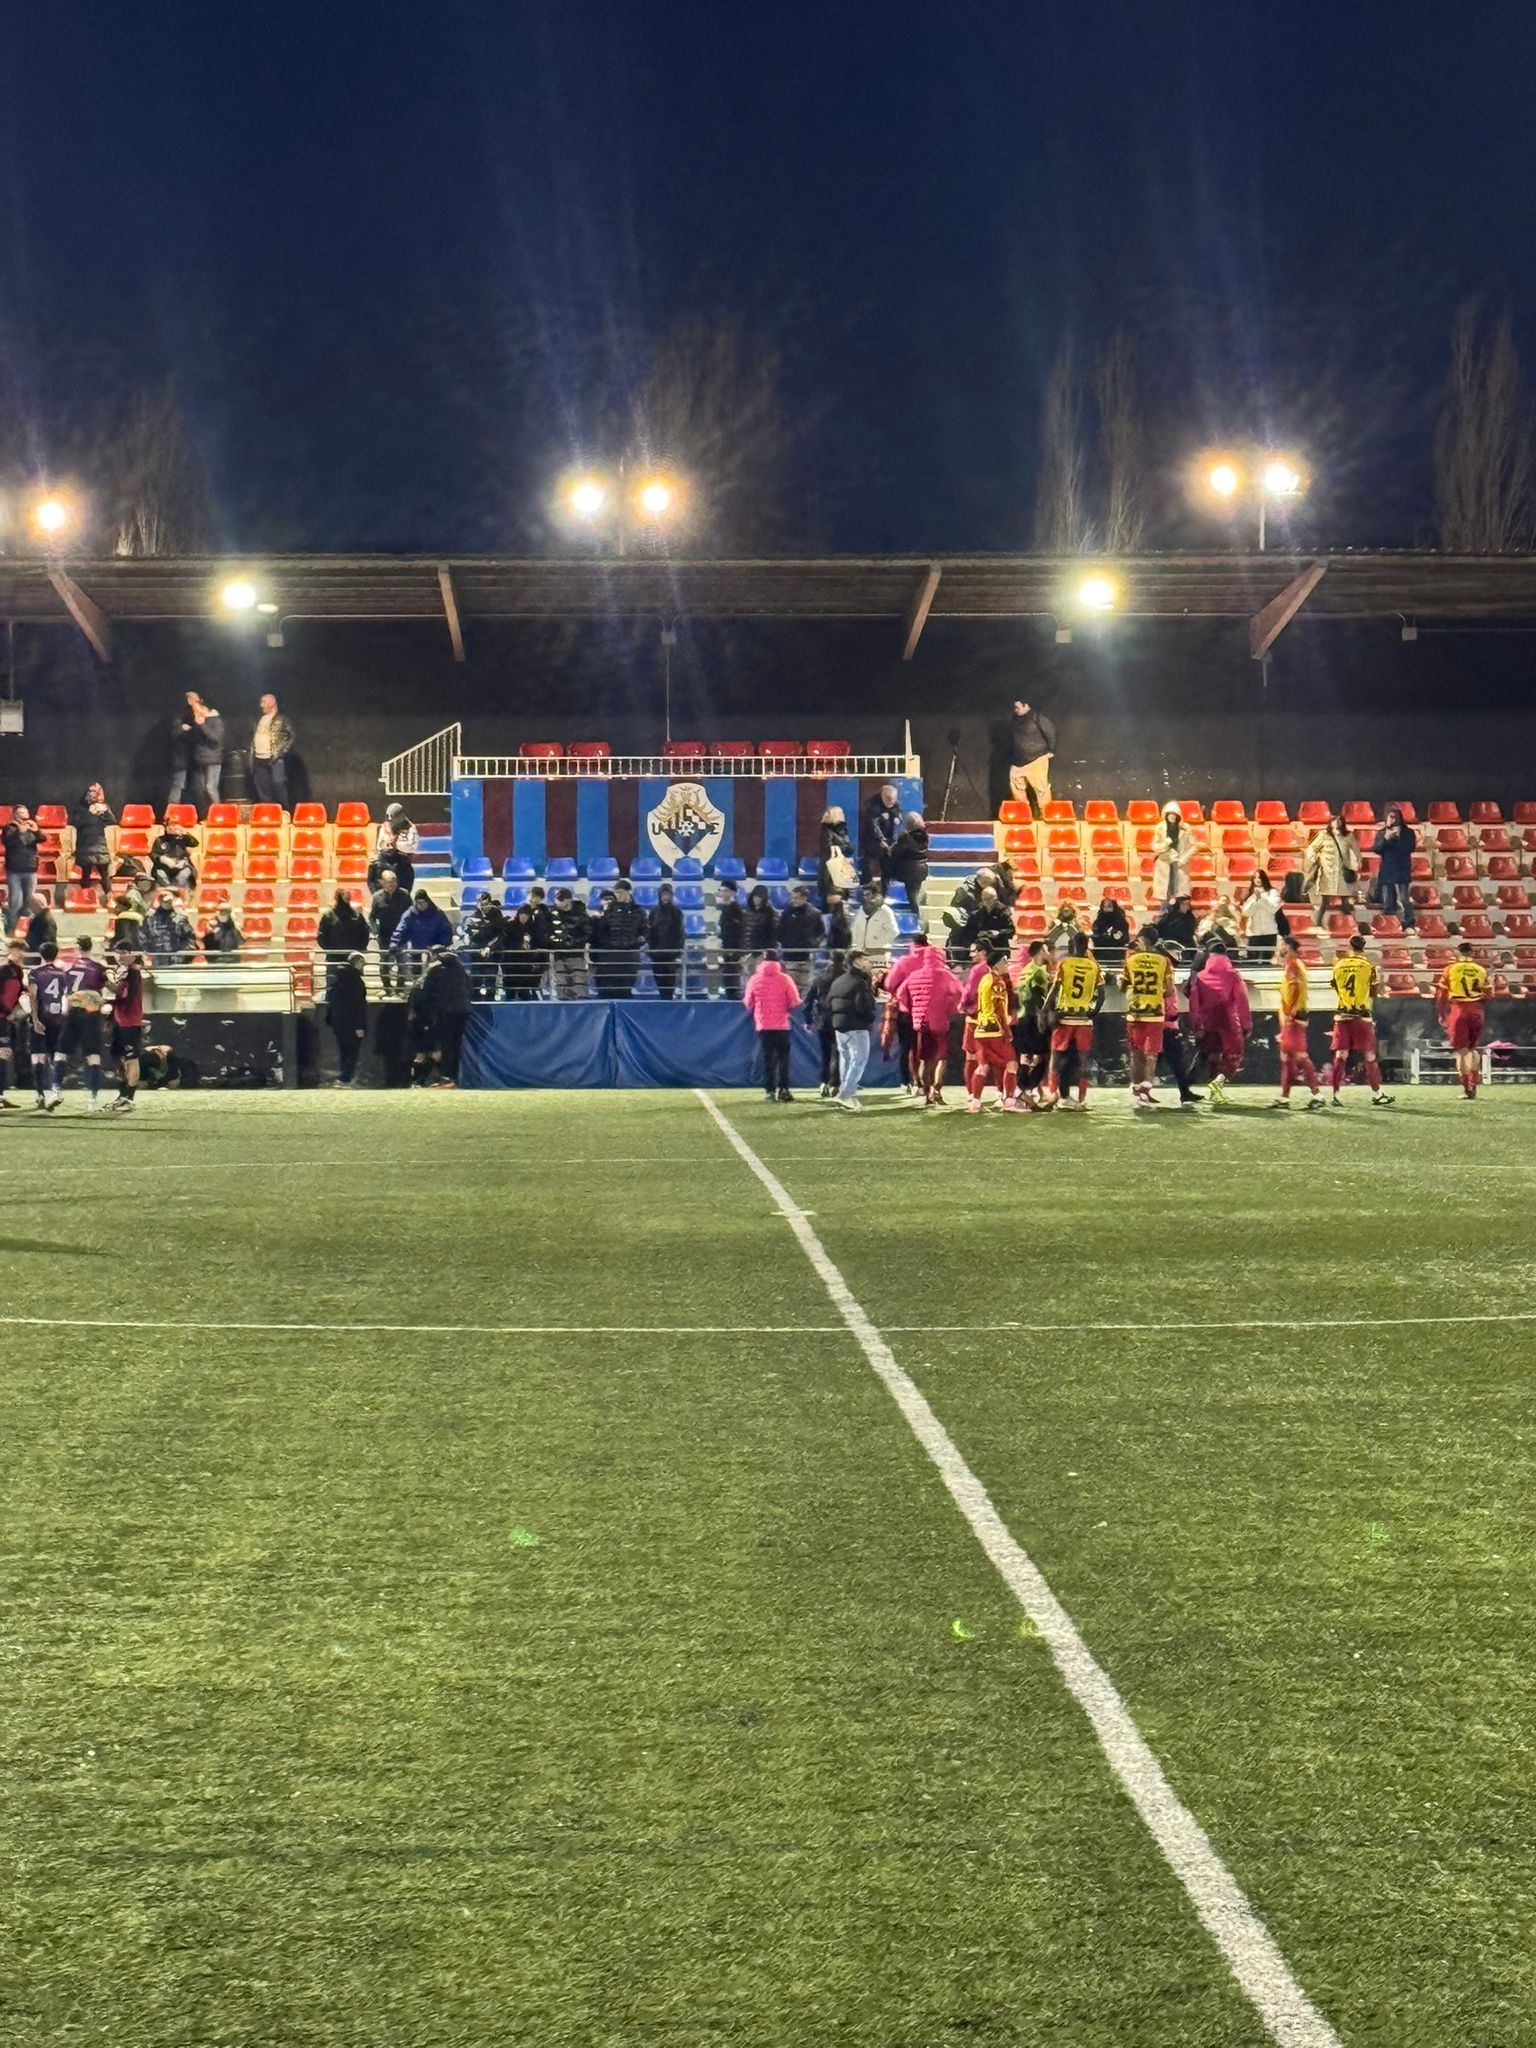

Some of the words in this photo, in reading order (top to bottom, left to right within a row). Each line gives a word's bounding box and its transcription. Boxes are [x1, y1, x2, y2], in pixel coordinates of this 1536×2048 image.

[652, 823, 662, 835] U
[44, 978, 60, 999] 4
[68, 970, 85, 992] 7
[1071, 975, 1085, 999] 5
[1133, 971, 1158, 995] 22
[1343, 974, 1356, 997] 4
